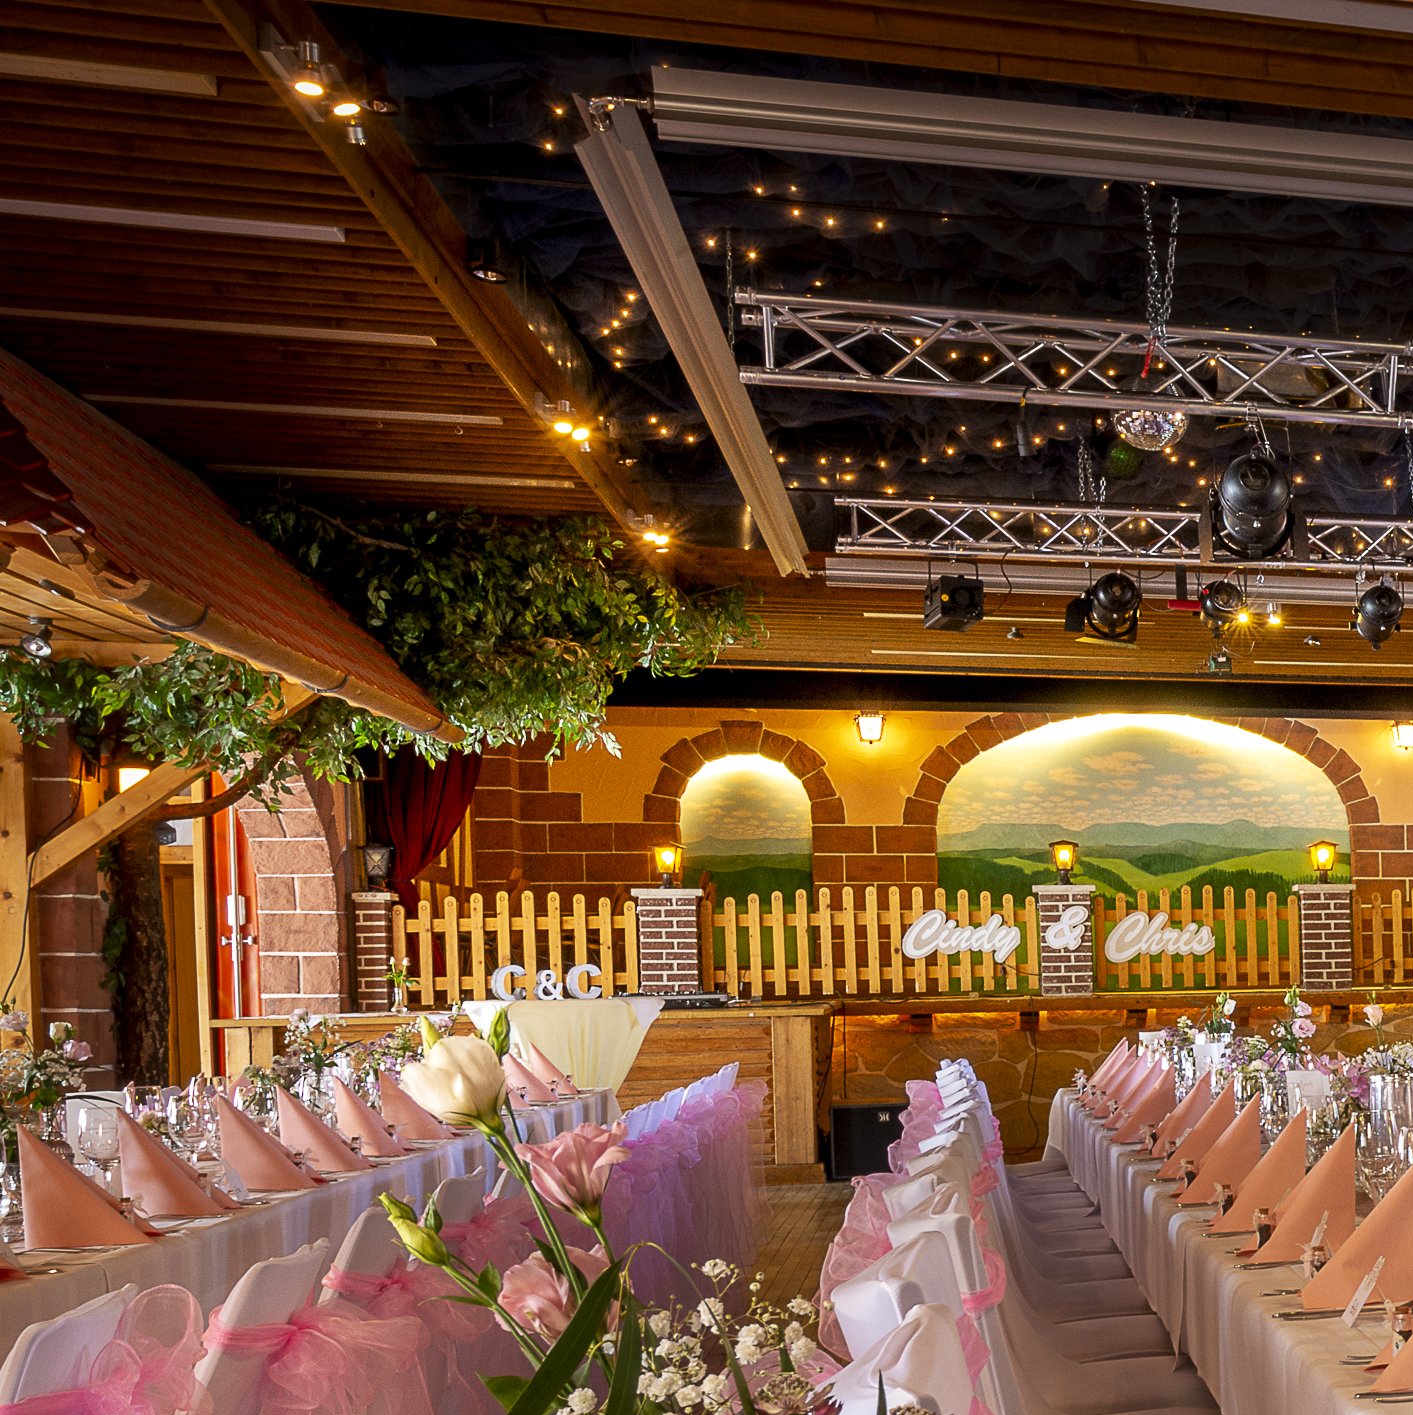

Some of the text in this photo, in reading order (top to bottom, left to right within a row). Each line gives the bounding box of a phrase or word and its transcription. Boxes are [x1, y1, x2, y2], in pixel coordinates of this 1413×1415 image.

[902, 905, 1216, 964] Cindy & Chris
